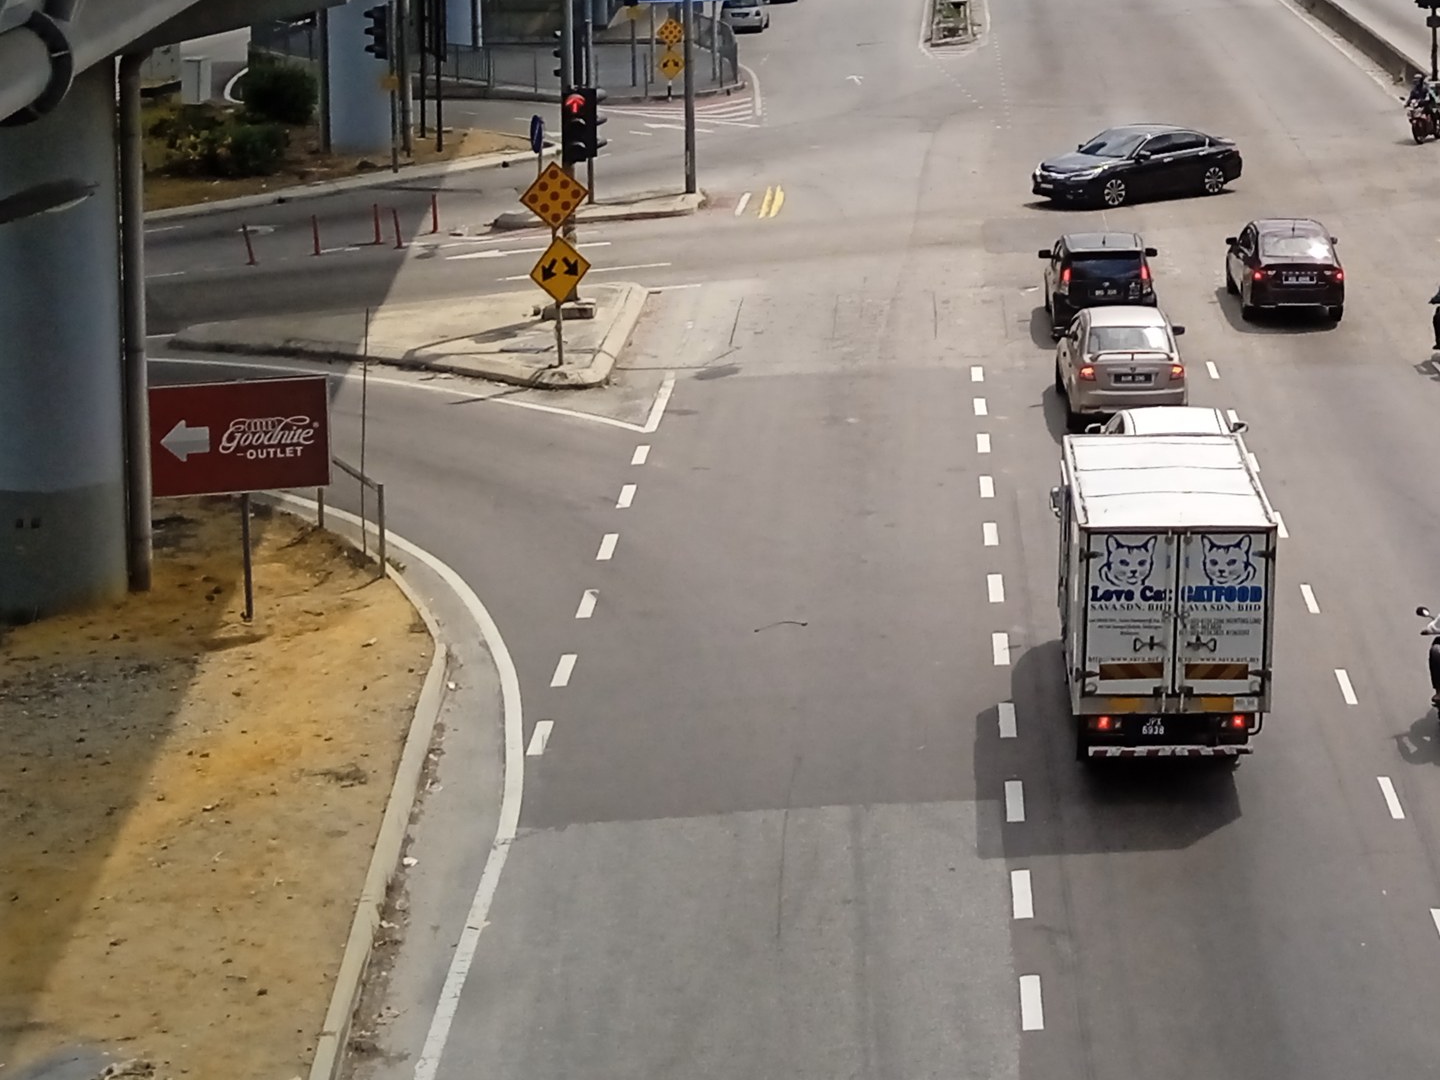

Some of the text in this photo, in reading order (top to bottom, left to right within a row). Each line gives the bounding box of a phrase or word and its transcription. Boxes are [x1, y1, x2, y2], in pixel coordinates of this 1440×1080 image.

[1090, 585, 1134, 602] Love
[1181, 585, 1262, 603] CATFOOD
[1182, 603, 1207, 612] AVA
